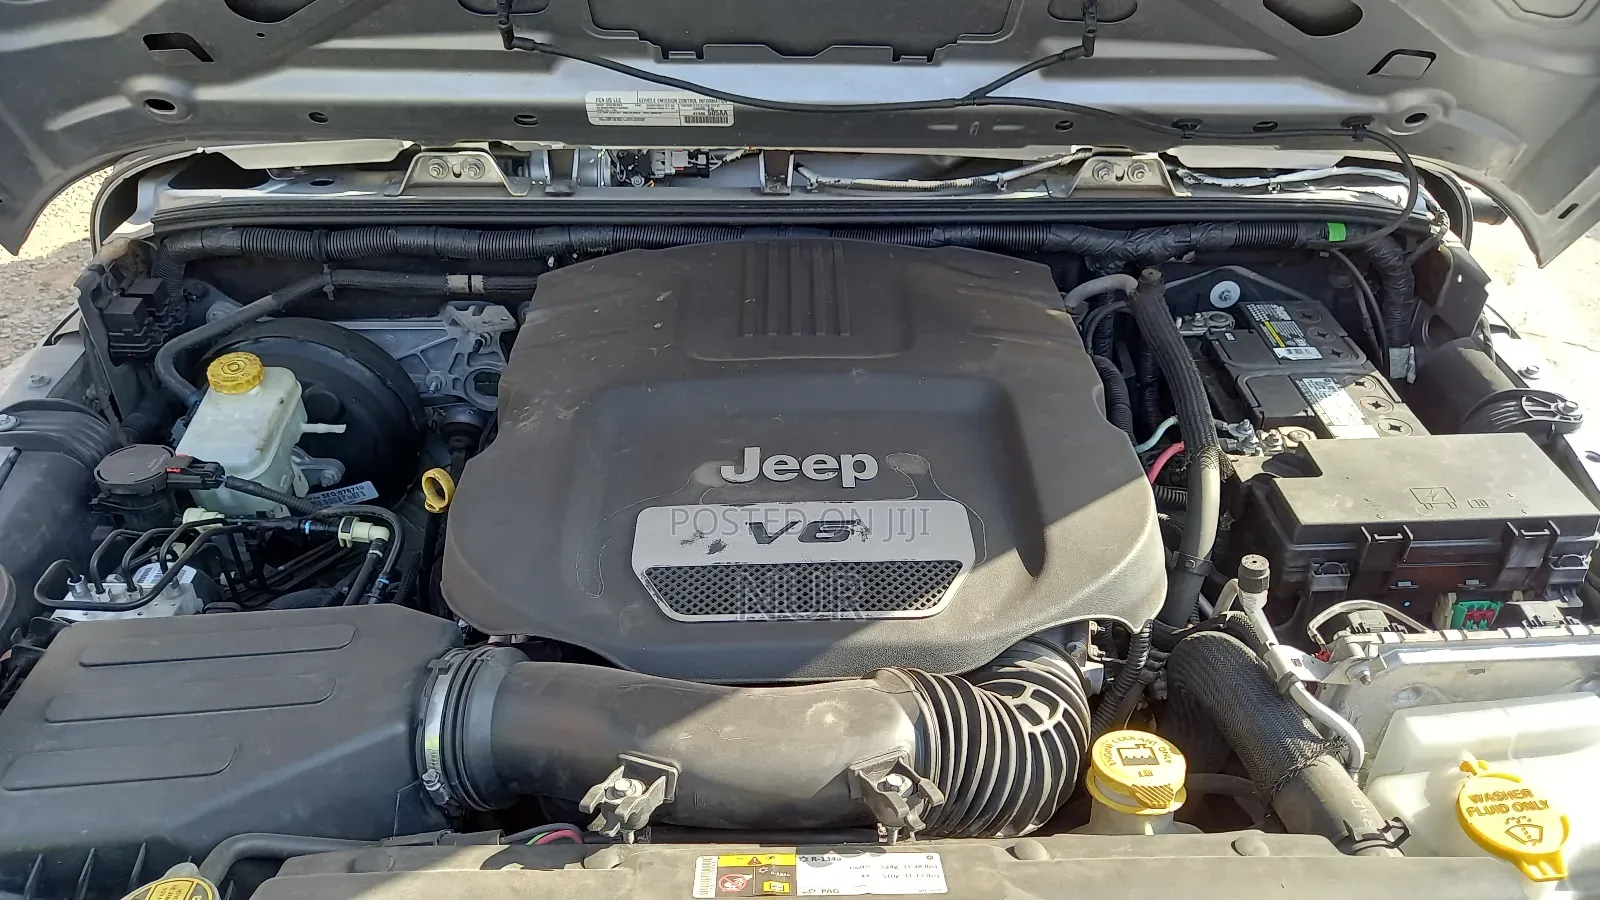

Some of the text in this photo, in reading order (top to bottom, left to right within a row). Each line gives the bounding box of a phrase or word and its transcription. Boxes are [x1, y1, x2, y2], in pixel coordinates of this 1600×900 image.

[719, 446, 880, 488] Jeep
[745, 518, 859, 545] V6
[1111, 736, 1158, 747] COOLANT
[1157, 746, 1172, 764] ONLY
[1465, 799, 1550, 818] FLUID ONLY
[1467, 788, 1534, 804] WASHER
